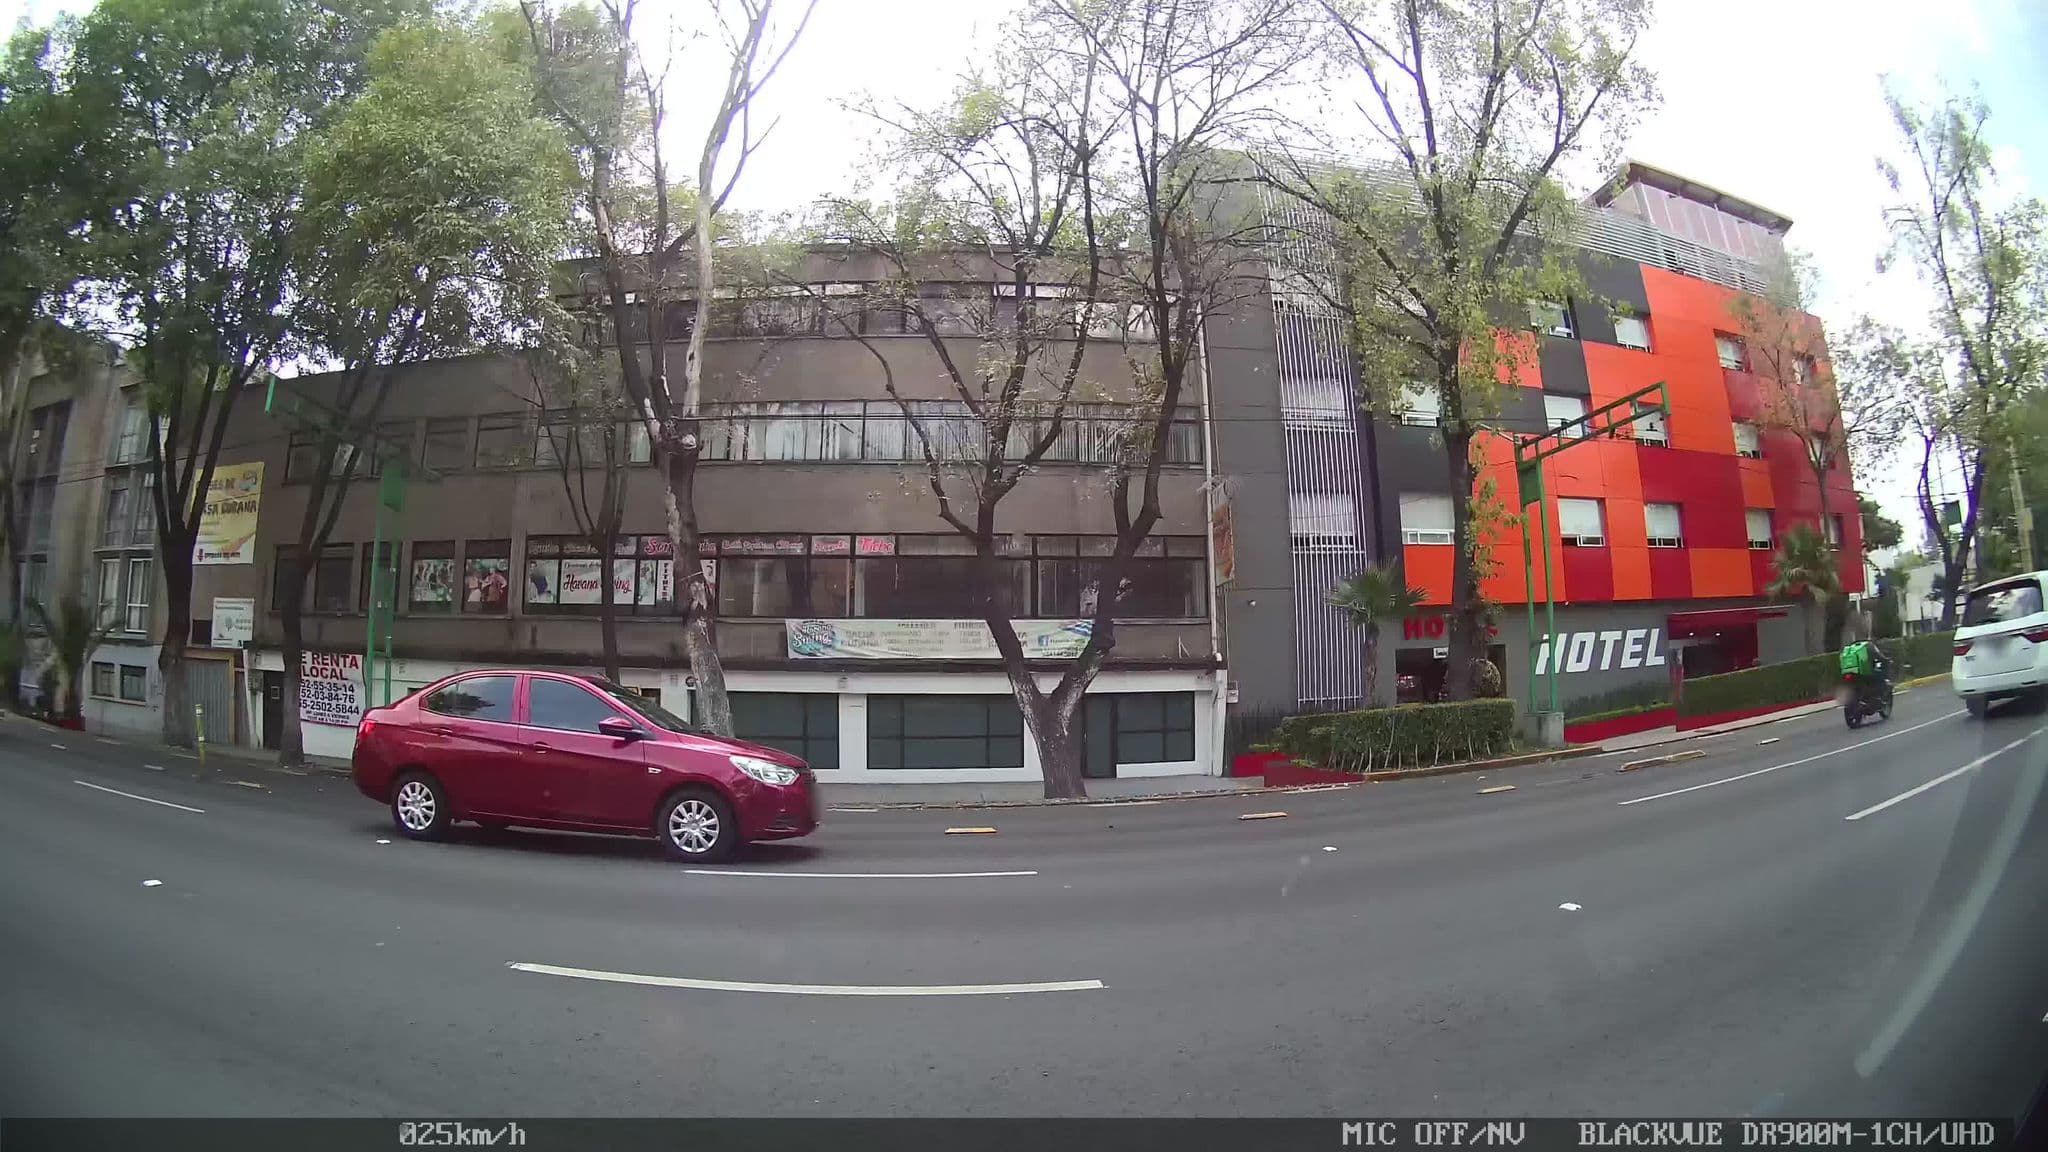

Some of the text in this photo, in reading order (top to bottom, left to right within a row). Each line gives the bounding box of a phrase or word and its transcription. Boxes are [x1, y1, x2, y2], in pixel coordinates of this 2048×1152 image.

[563, 573, 599, 592] Havana
[614, 577, 632, 593] ing
[1535, 628, 1665, 675] HOTEL
[312, 653, 359, 669] RENTA
[302, 665, 348, 680] LOCAL
[301, 688, 355, 703] 52-03-84-76
